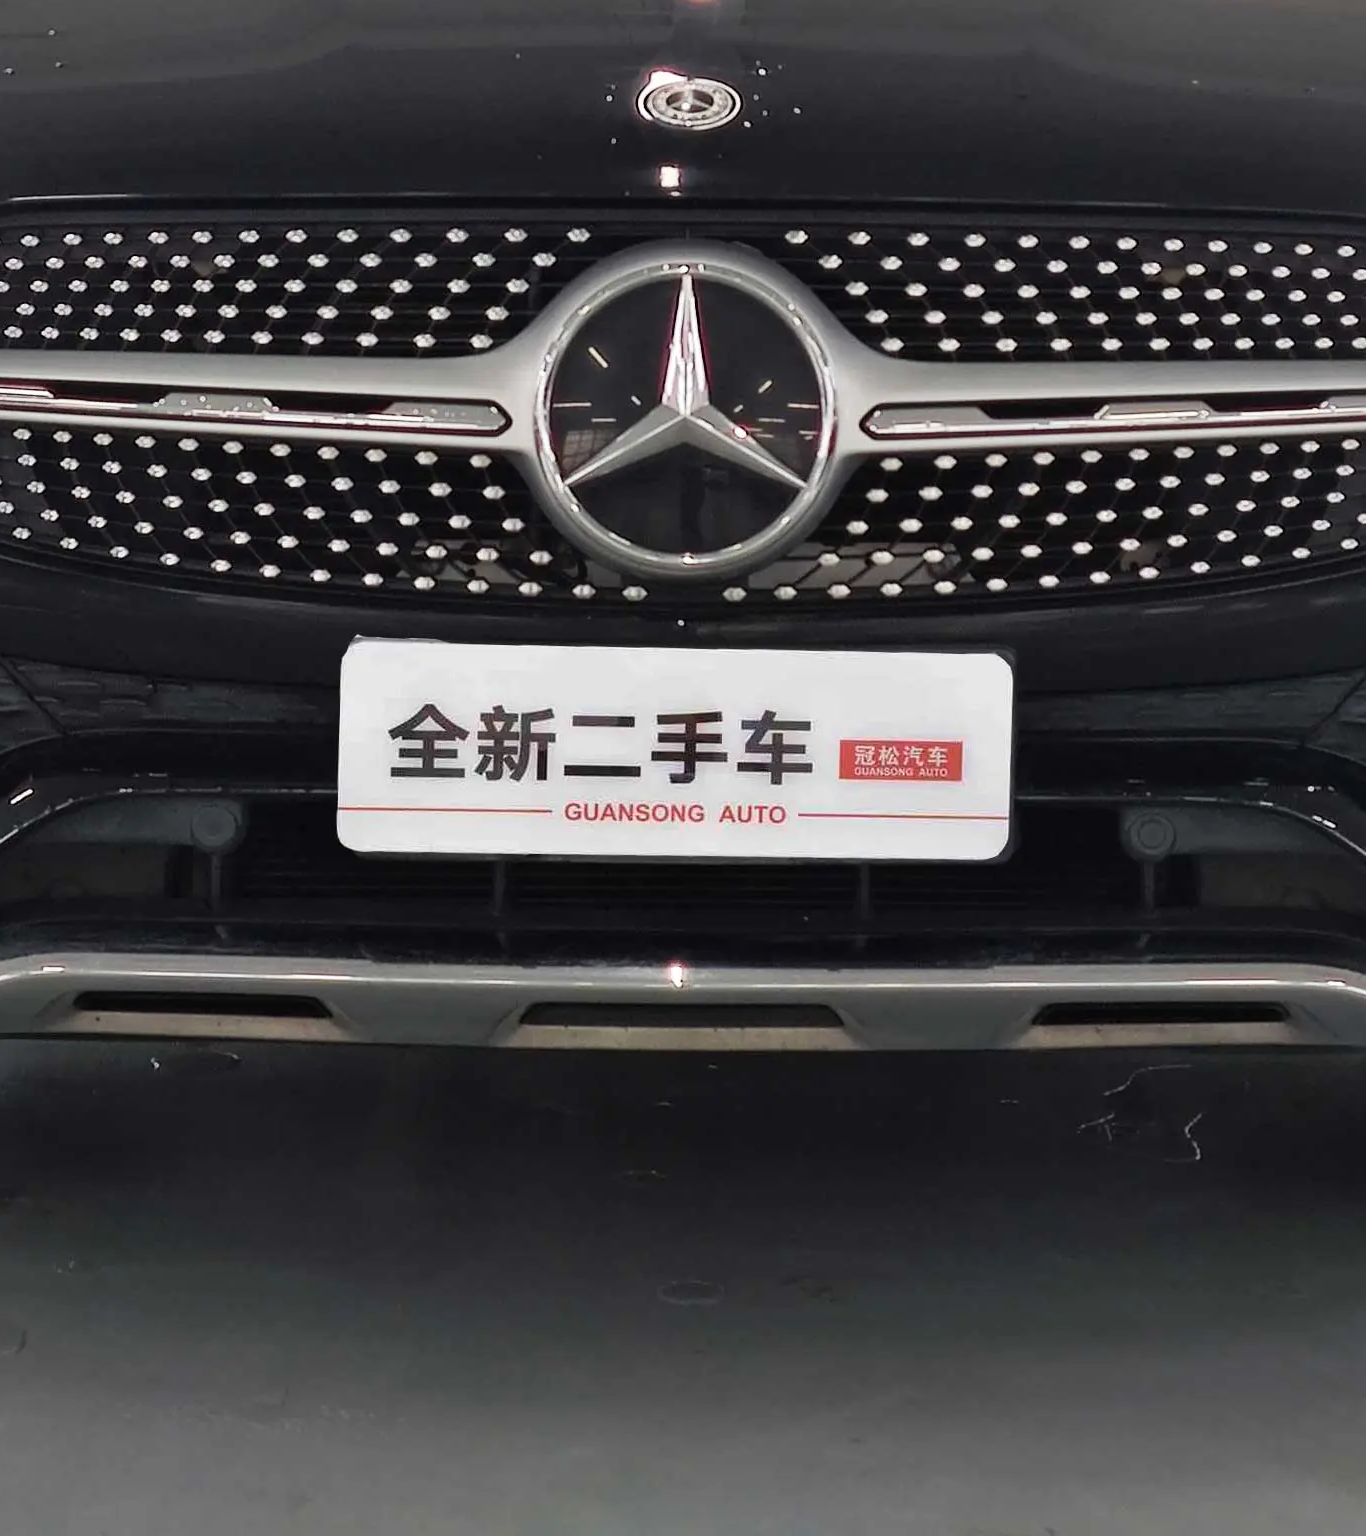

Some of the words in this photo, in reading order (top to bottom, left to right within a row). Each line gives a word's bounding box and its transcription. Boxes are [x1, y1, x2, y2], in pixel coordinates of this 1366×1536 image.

[388, 703, 814, 785] 全新二手车
[854, 745, 948, 767] 冠松汽车
[854, 767, 913, 777] GUANSONG
[919, 768, 948, 778] AUTO
[565, 801, 705, 825] GUANSONG
[718, 803, 789, 825] AUTO
